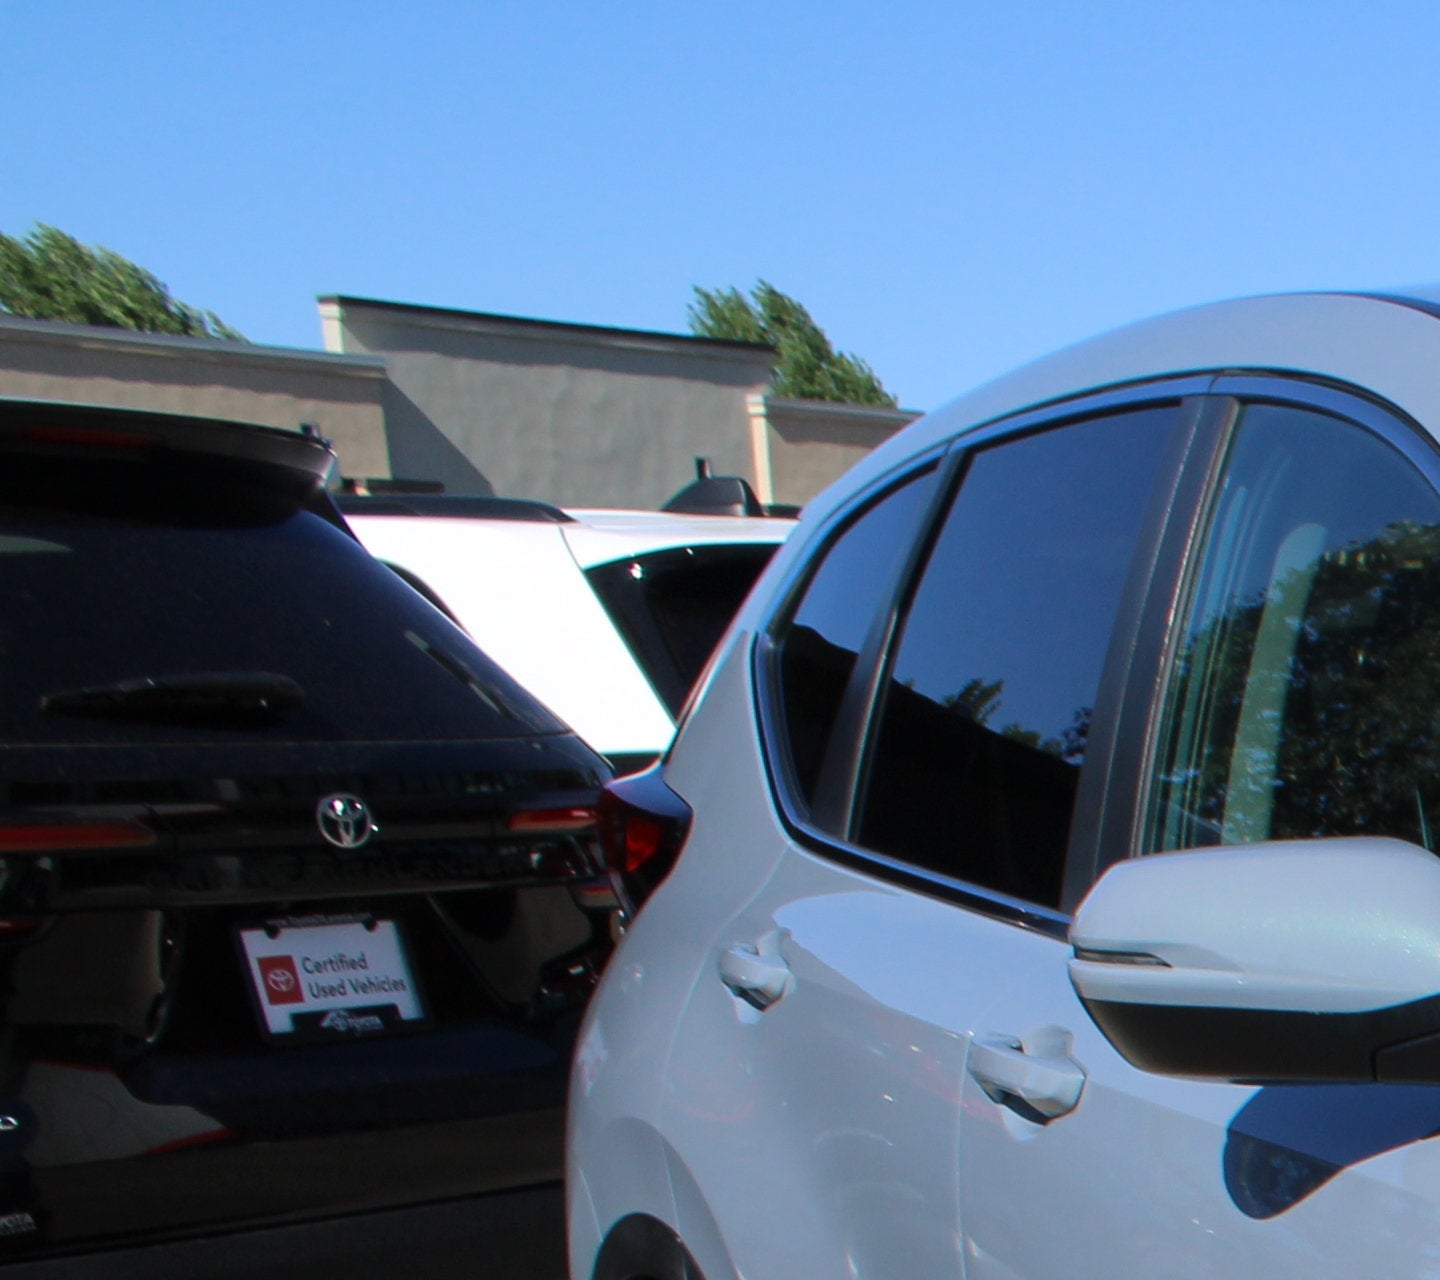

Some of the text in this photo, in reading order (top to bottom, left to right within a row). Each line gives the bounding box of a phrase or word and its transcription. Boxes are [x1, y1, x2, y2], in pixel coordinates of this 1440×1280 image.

[301, 950, 369, 974] Certified
[307, 975, 408, 999] Used Vehicles
